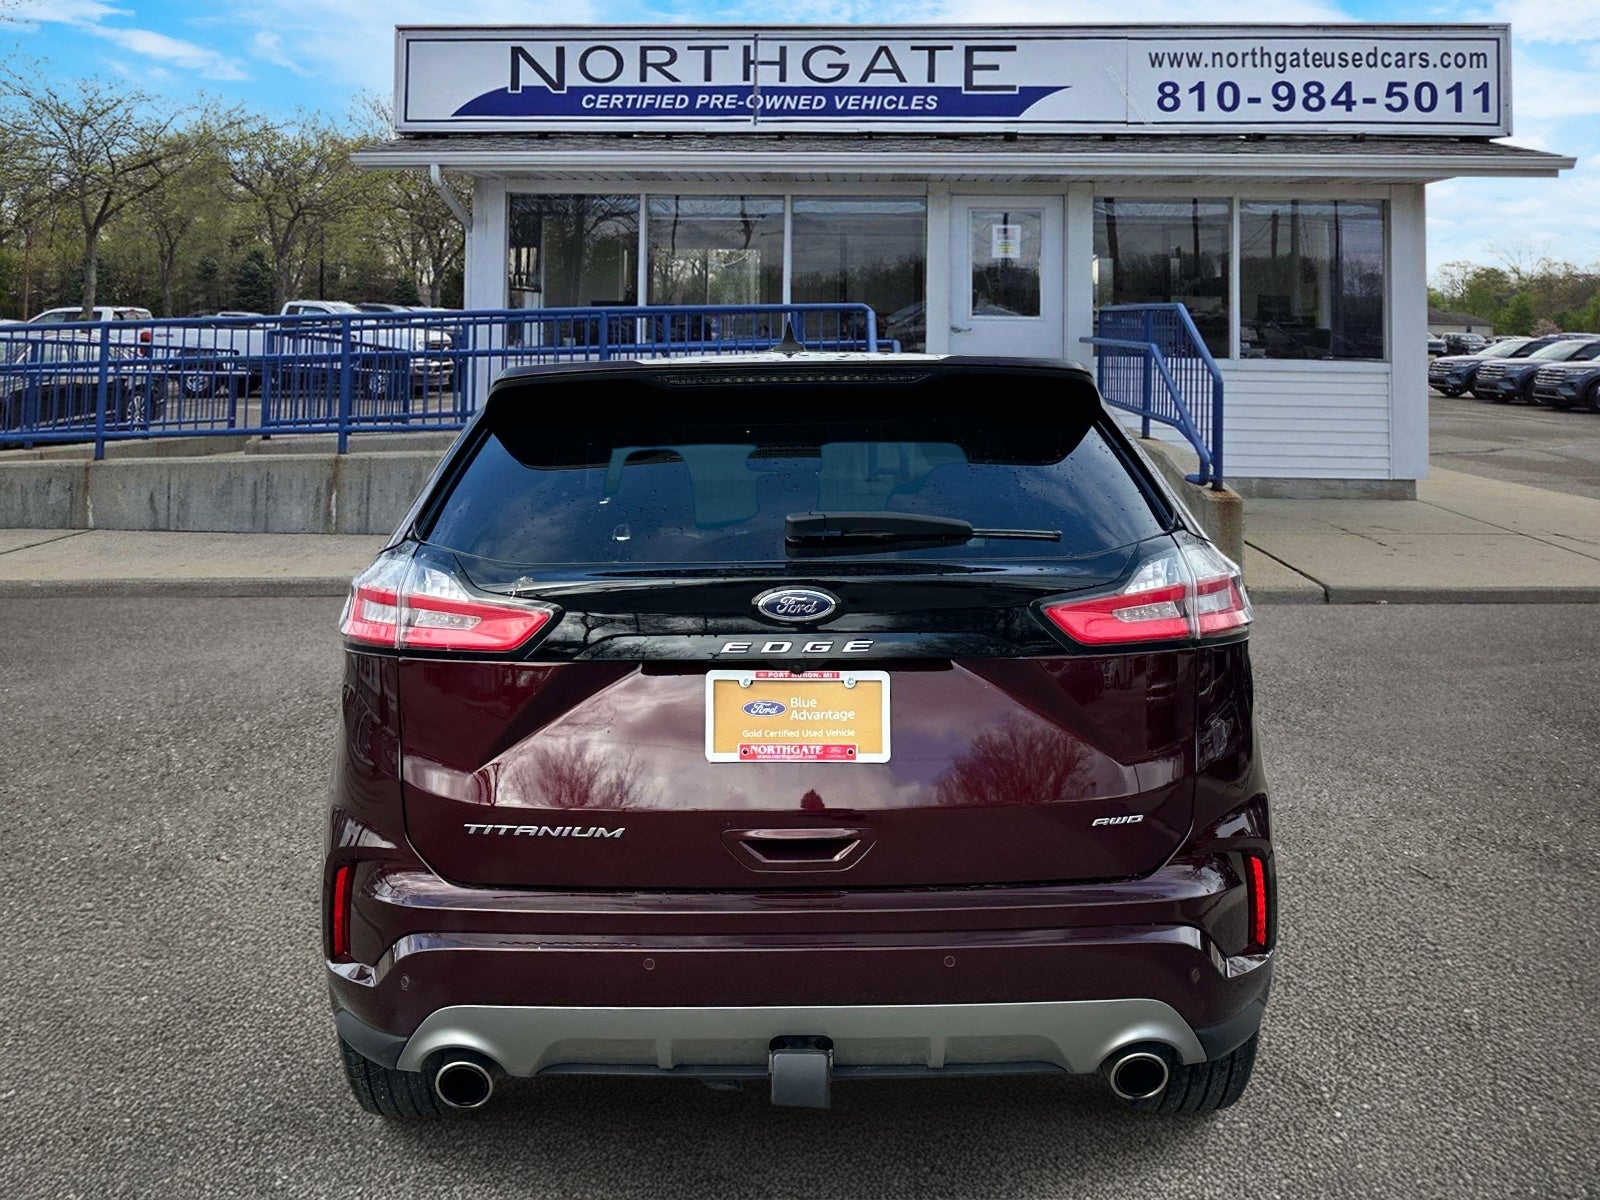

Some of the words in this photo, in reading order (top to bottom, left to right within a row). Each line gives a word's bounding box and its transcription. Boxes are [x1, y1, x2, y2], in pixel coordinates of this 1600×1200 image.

[1149, 46, 1488, 74] www.northgateusedcars.com
[508, 44, 1017, 93] NORTHGATE
[581, 94, 689, 110] CERTIFIED
[694, 94, 827, 111] PRE-OWNED
[834, 94, 938, 111] VEHICLES
[1156, 80, 1491, 113] 810-984-5011
[776, 596, 818, 615] Ford
[720, 640, 874, 654] EDGE
[751, 702, 778, 715] Ford
[790, 697, 818, 708] Blue
[790, 709, 856, 722] Advantage
[742, 729, 762, 738] Gold
[764, 729, 800, 738] Certified
[801, 729, 824, 738] Used
[825, 728, 856, 737] Vehicle
[750, 745, 823, 755] NORTHGATE
[1092, 814, 1144, 827] AWD
[464, 823, 626, 839] TITANIUM
